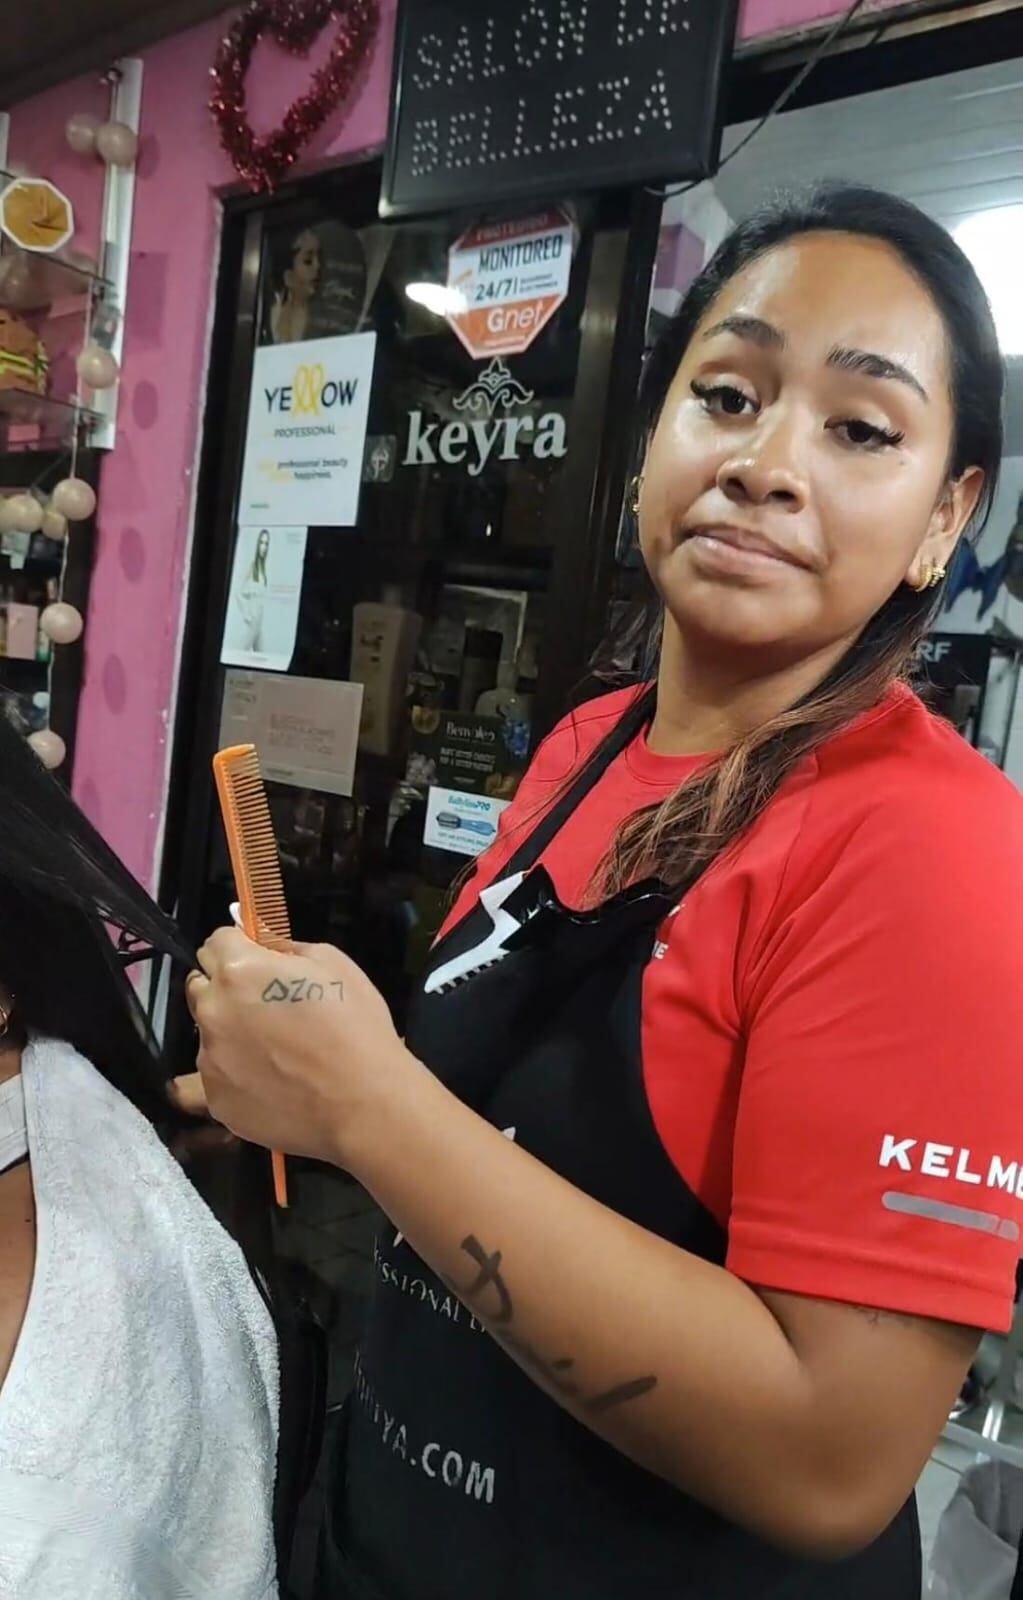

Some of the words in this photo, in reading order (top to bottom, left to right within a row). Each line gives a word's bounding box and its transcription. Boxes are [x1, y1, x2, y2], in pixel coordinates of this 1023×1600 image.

[412, 0, 588, 89] SALON
[411, 68, 673, 177] BELLEZA
[477, 234, 564, 273] MONITORED
[487, 300, 545, 333] Gnet
[402, 411, 568, 476] keyra
